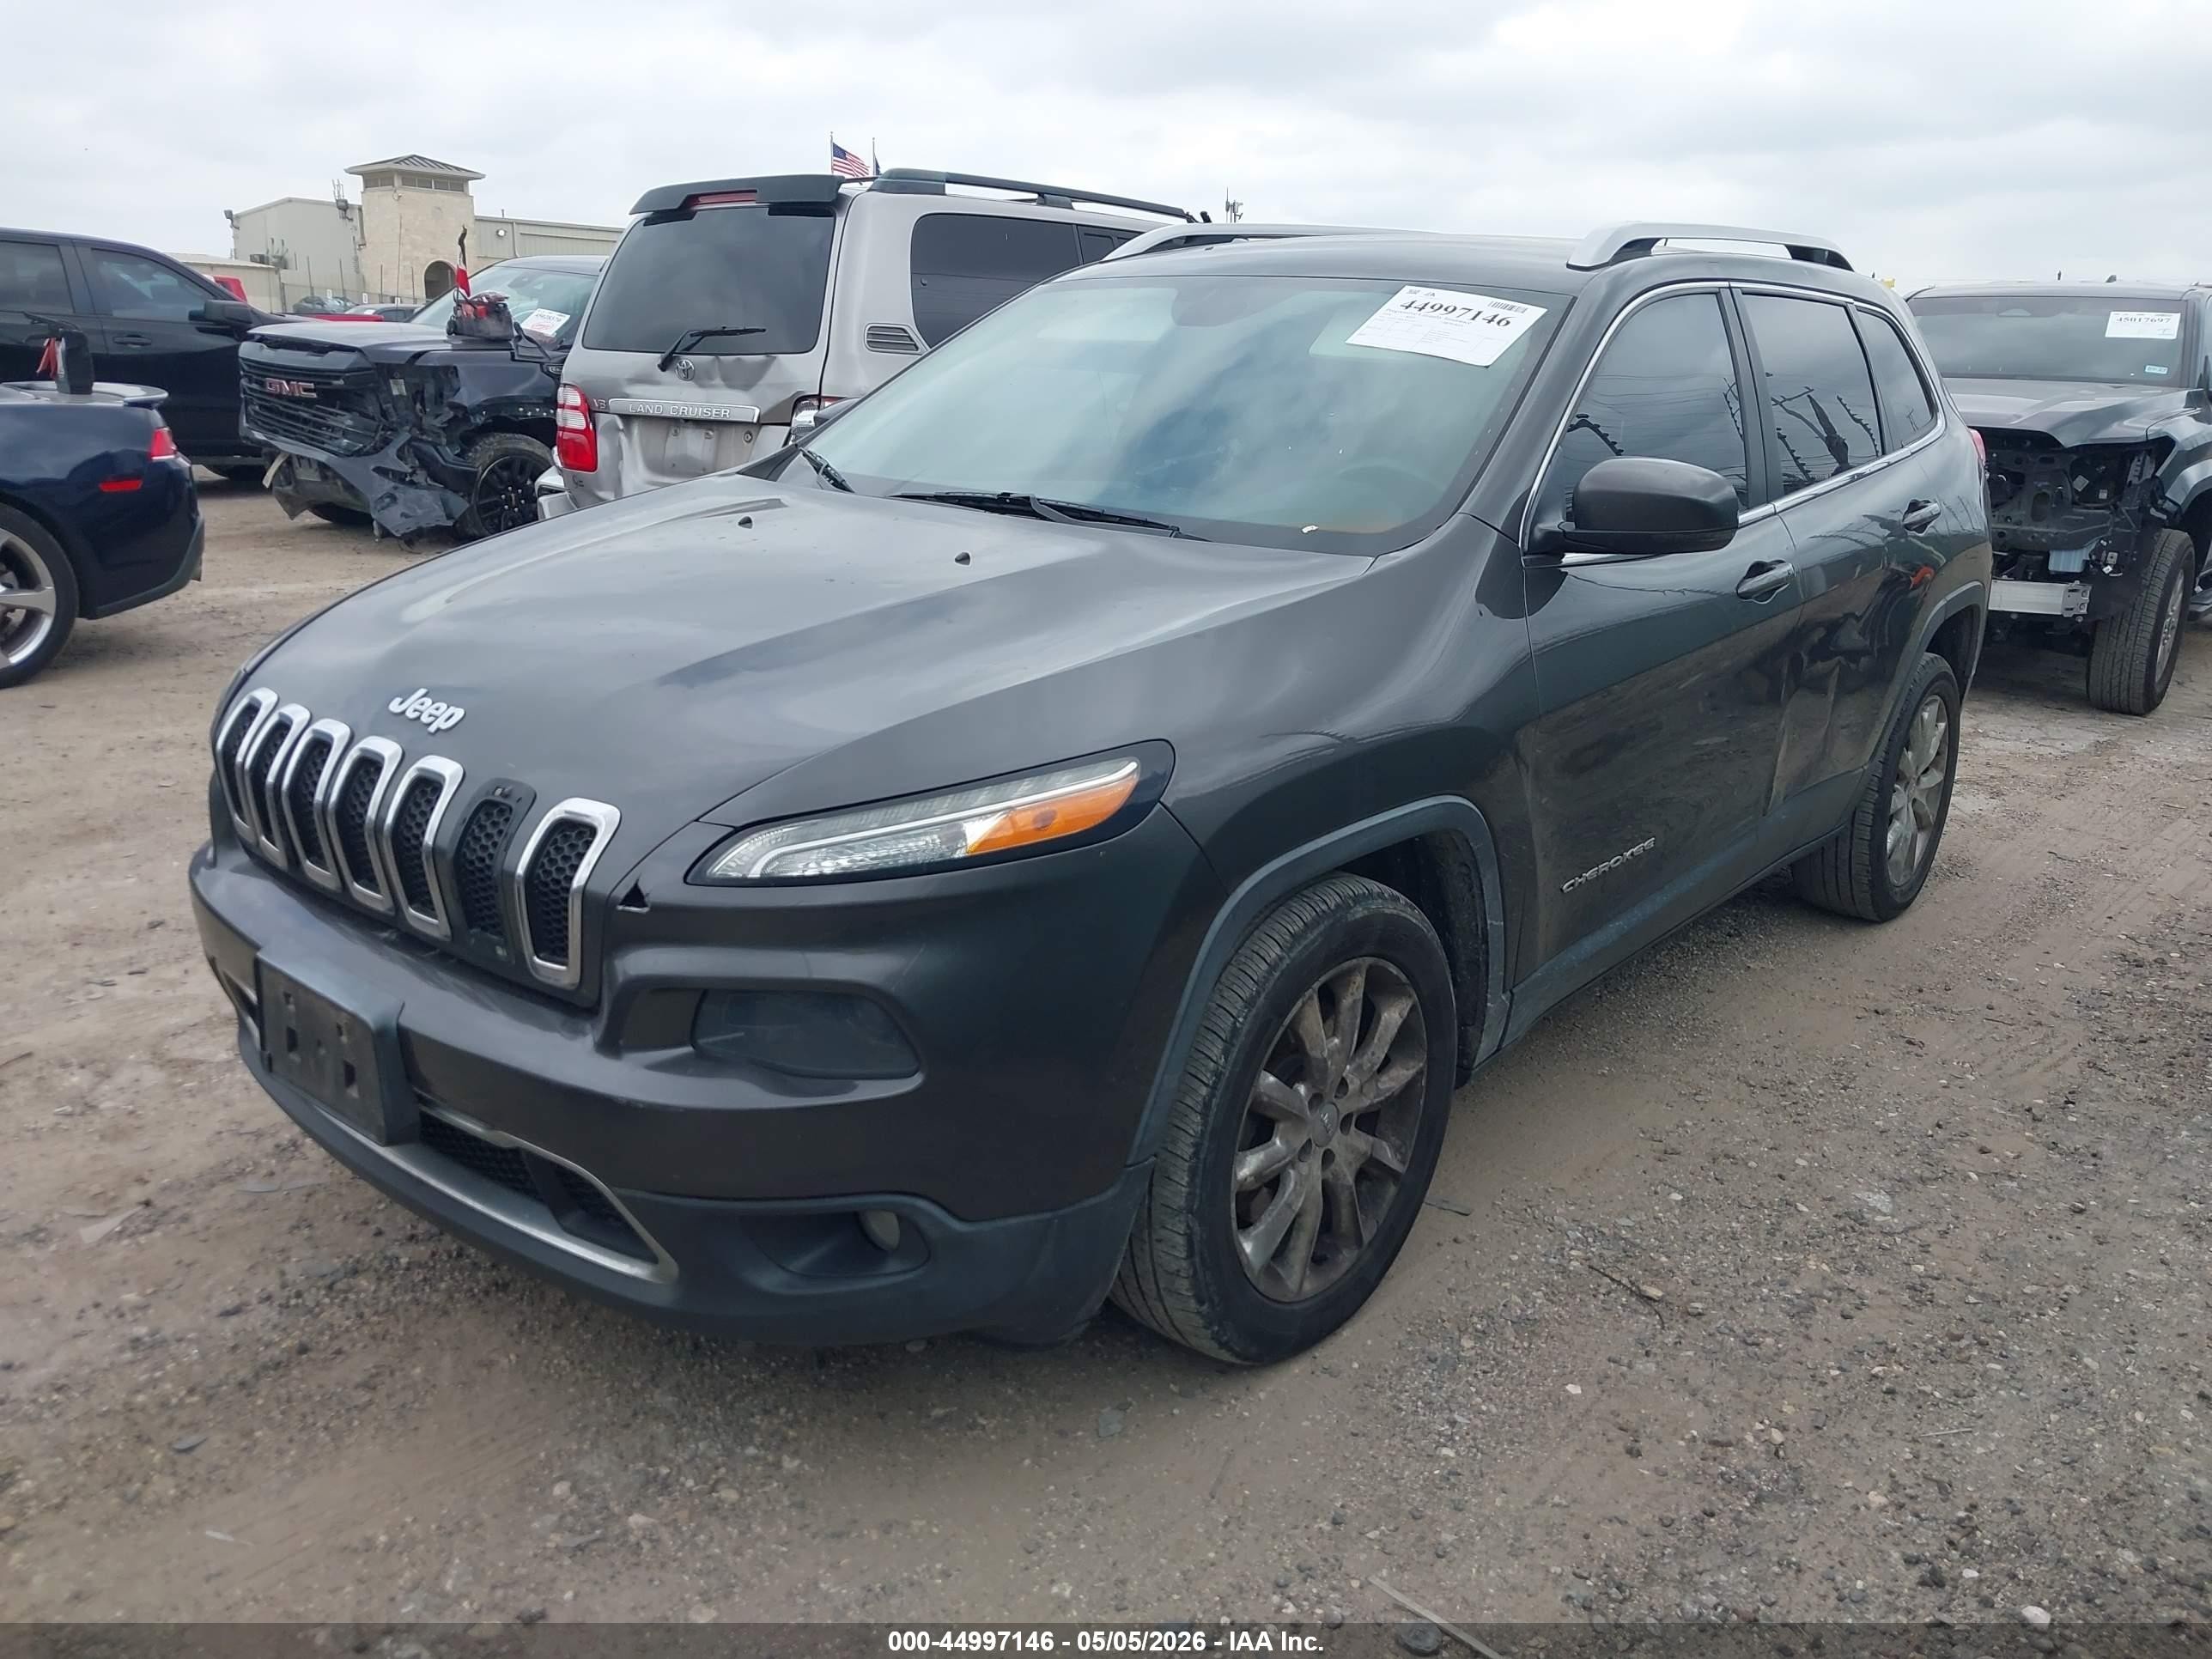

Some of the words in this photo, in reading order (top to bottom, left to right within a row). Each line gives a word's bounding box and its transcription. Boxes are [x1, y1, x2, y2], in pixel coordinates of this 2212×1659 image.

[1400, 300, 1515, 327] 44997146
[265, 377, 318, 398] GMC
[629, 403, 664, 414] LAND
[670, 404, 731, 419] CRUISER
[388, 688, 465, 734] Jeep
[1562, 836, 1656, 893] CHEROKEE
